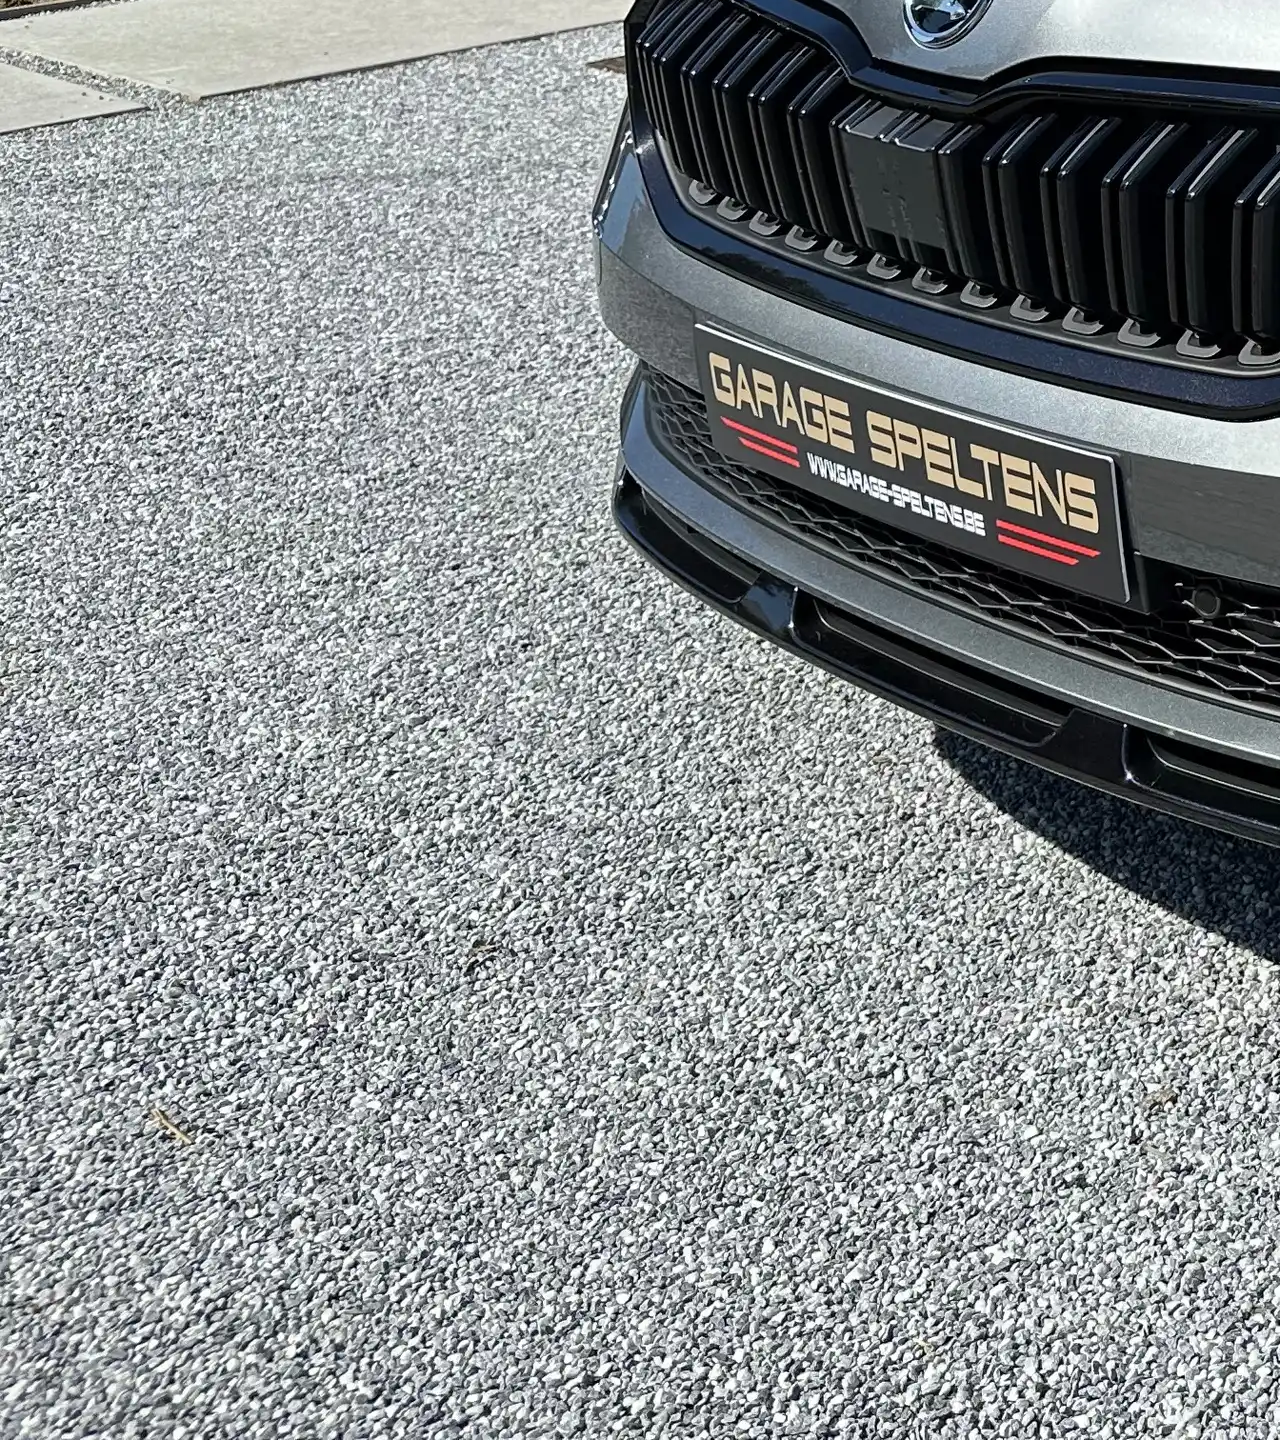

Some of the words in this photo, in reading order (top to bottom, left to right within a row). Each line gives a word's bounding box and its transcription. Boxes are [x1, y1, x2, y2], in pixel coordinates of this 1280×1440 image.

[708, 352, 854, 454] GARAGE
[866, 410, 1099, 534] SPELTENS
[807, 453, 985, 537] WWW.GARAGE-SPELTENS.BE
